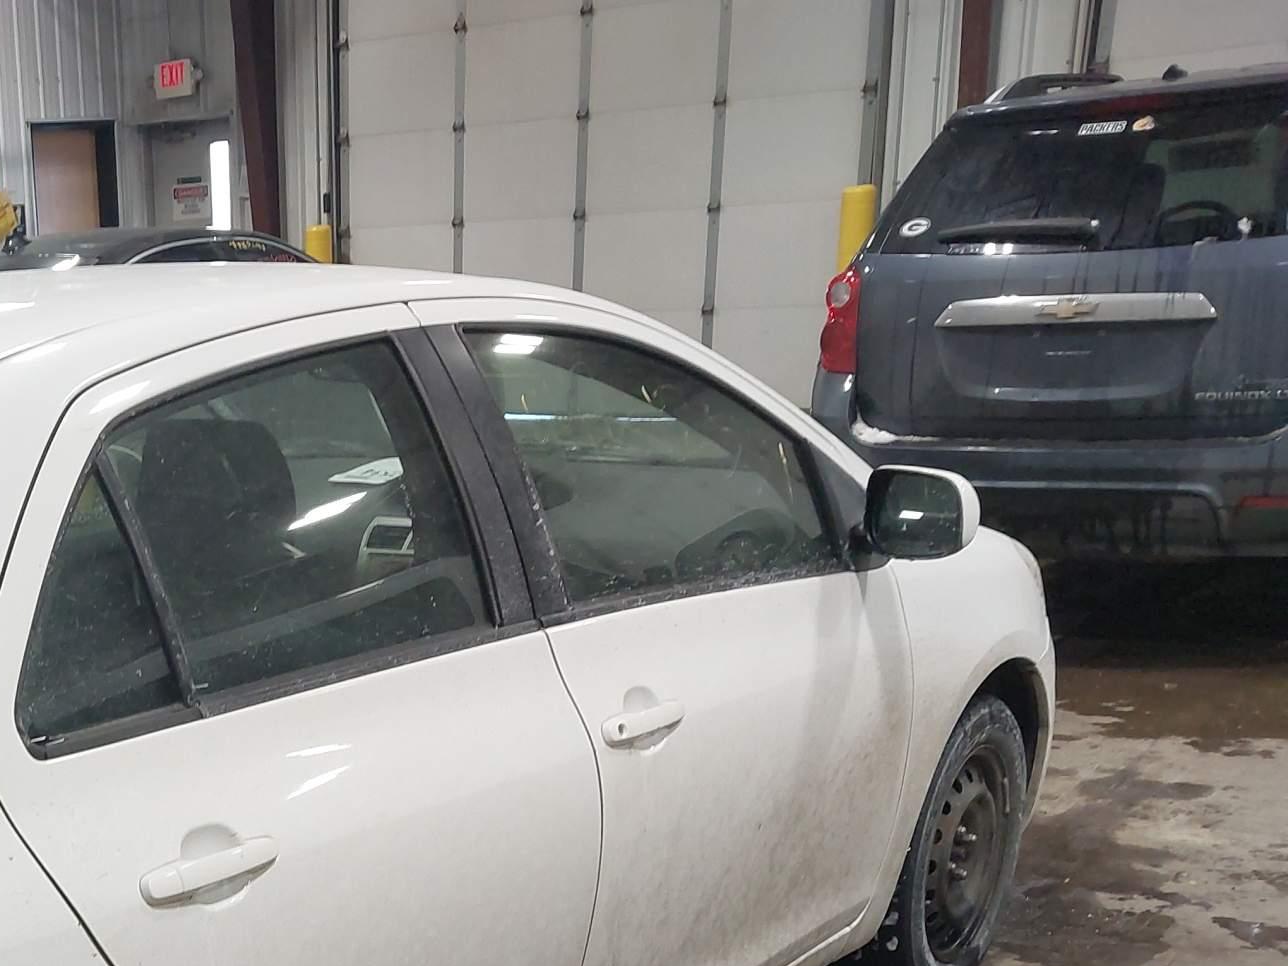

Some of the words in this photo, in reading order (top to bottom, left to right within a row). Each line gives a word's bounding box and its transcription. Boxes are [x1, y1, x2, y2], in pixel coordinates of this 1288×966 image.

[161, 61, 184, 88] EXIT
[1079, 121, 1127, 135] PACKERS
[1194, 390, 1272, 400] EQUINOX
